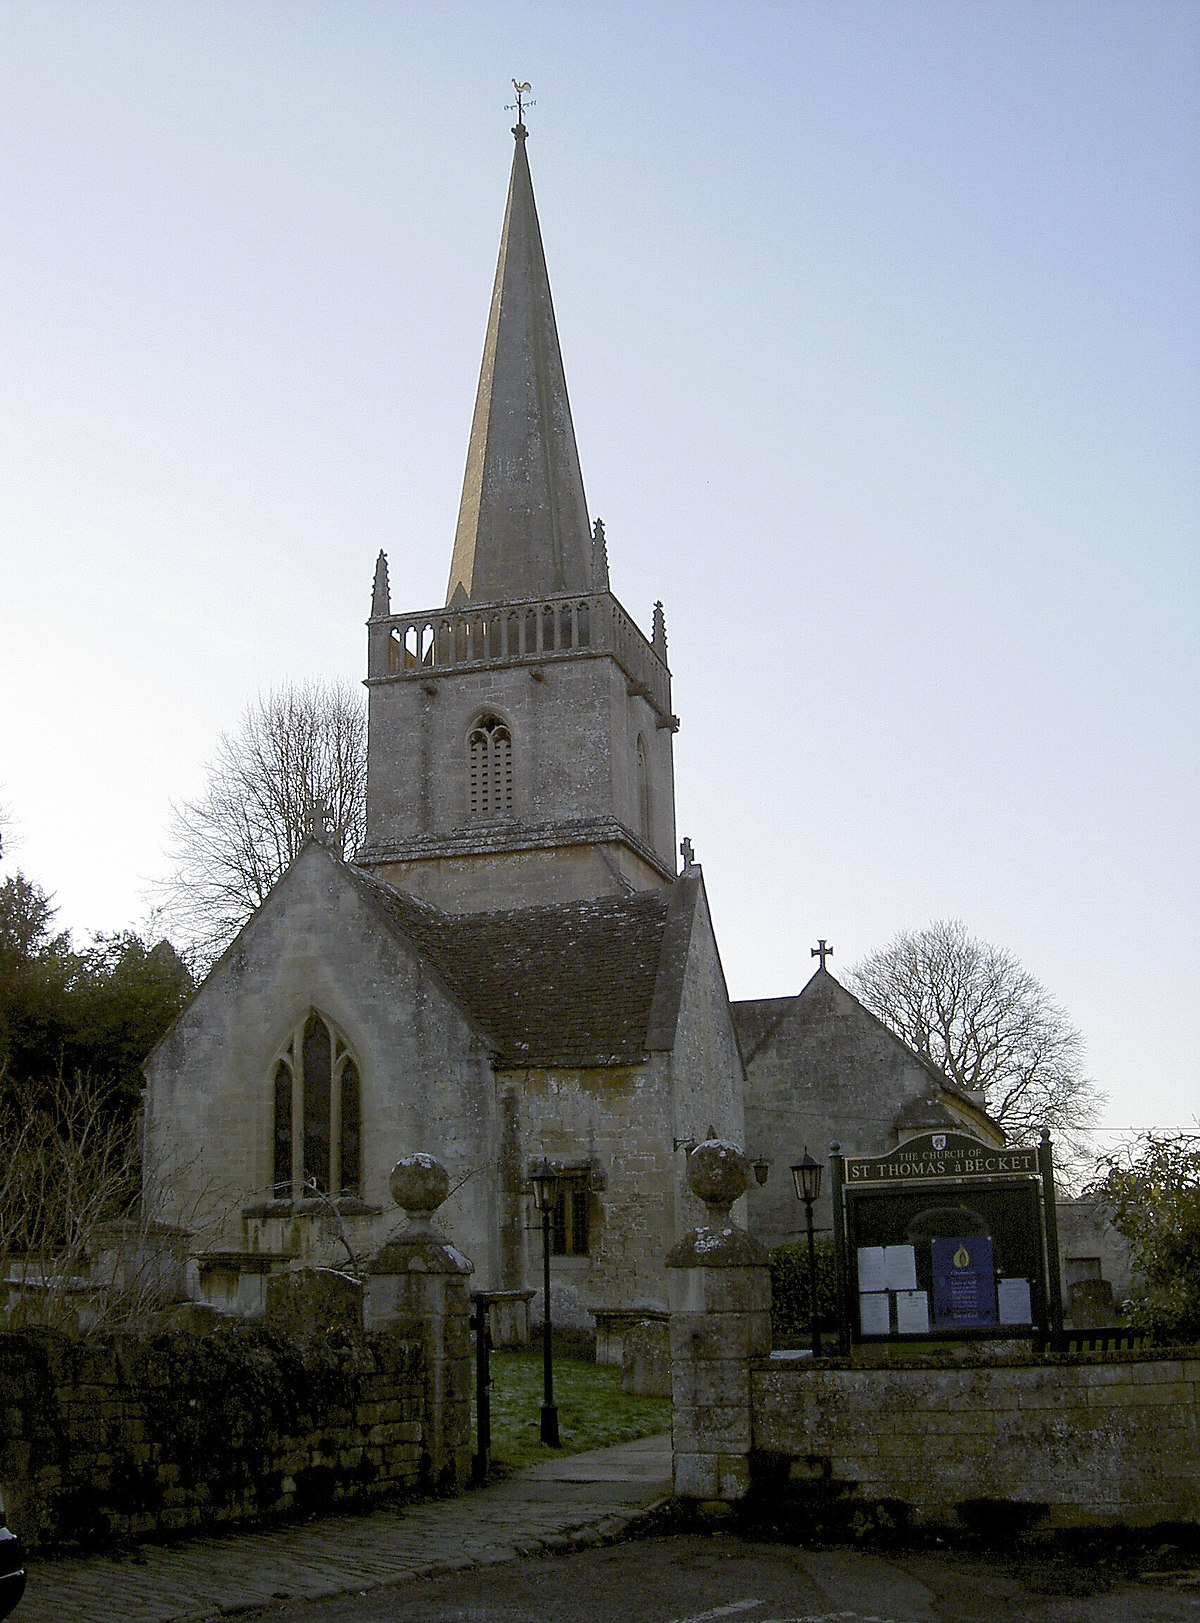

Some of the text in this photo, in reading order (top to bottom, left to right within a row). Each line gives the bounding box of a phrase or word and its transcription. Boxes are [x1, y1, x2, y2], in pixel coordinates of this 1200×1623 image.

[899, 1148, 982, 1161] THE CHURCH OF
[852, 1165, 870, 1178] ST
[877, 1161, 945, 1177] THOMAS
[965, 1156, 1031, 1172] BECKET
